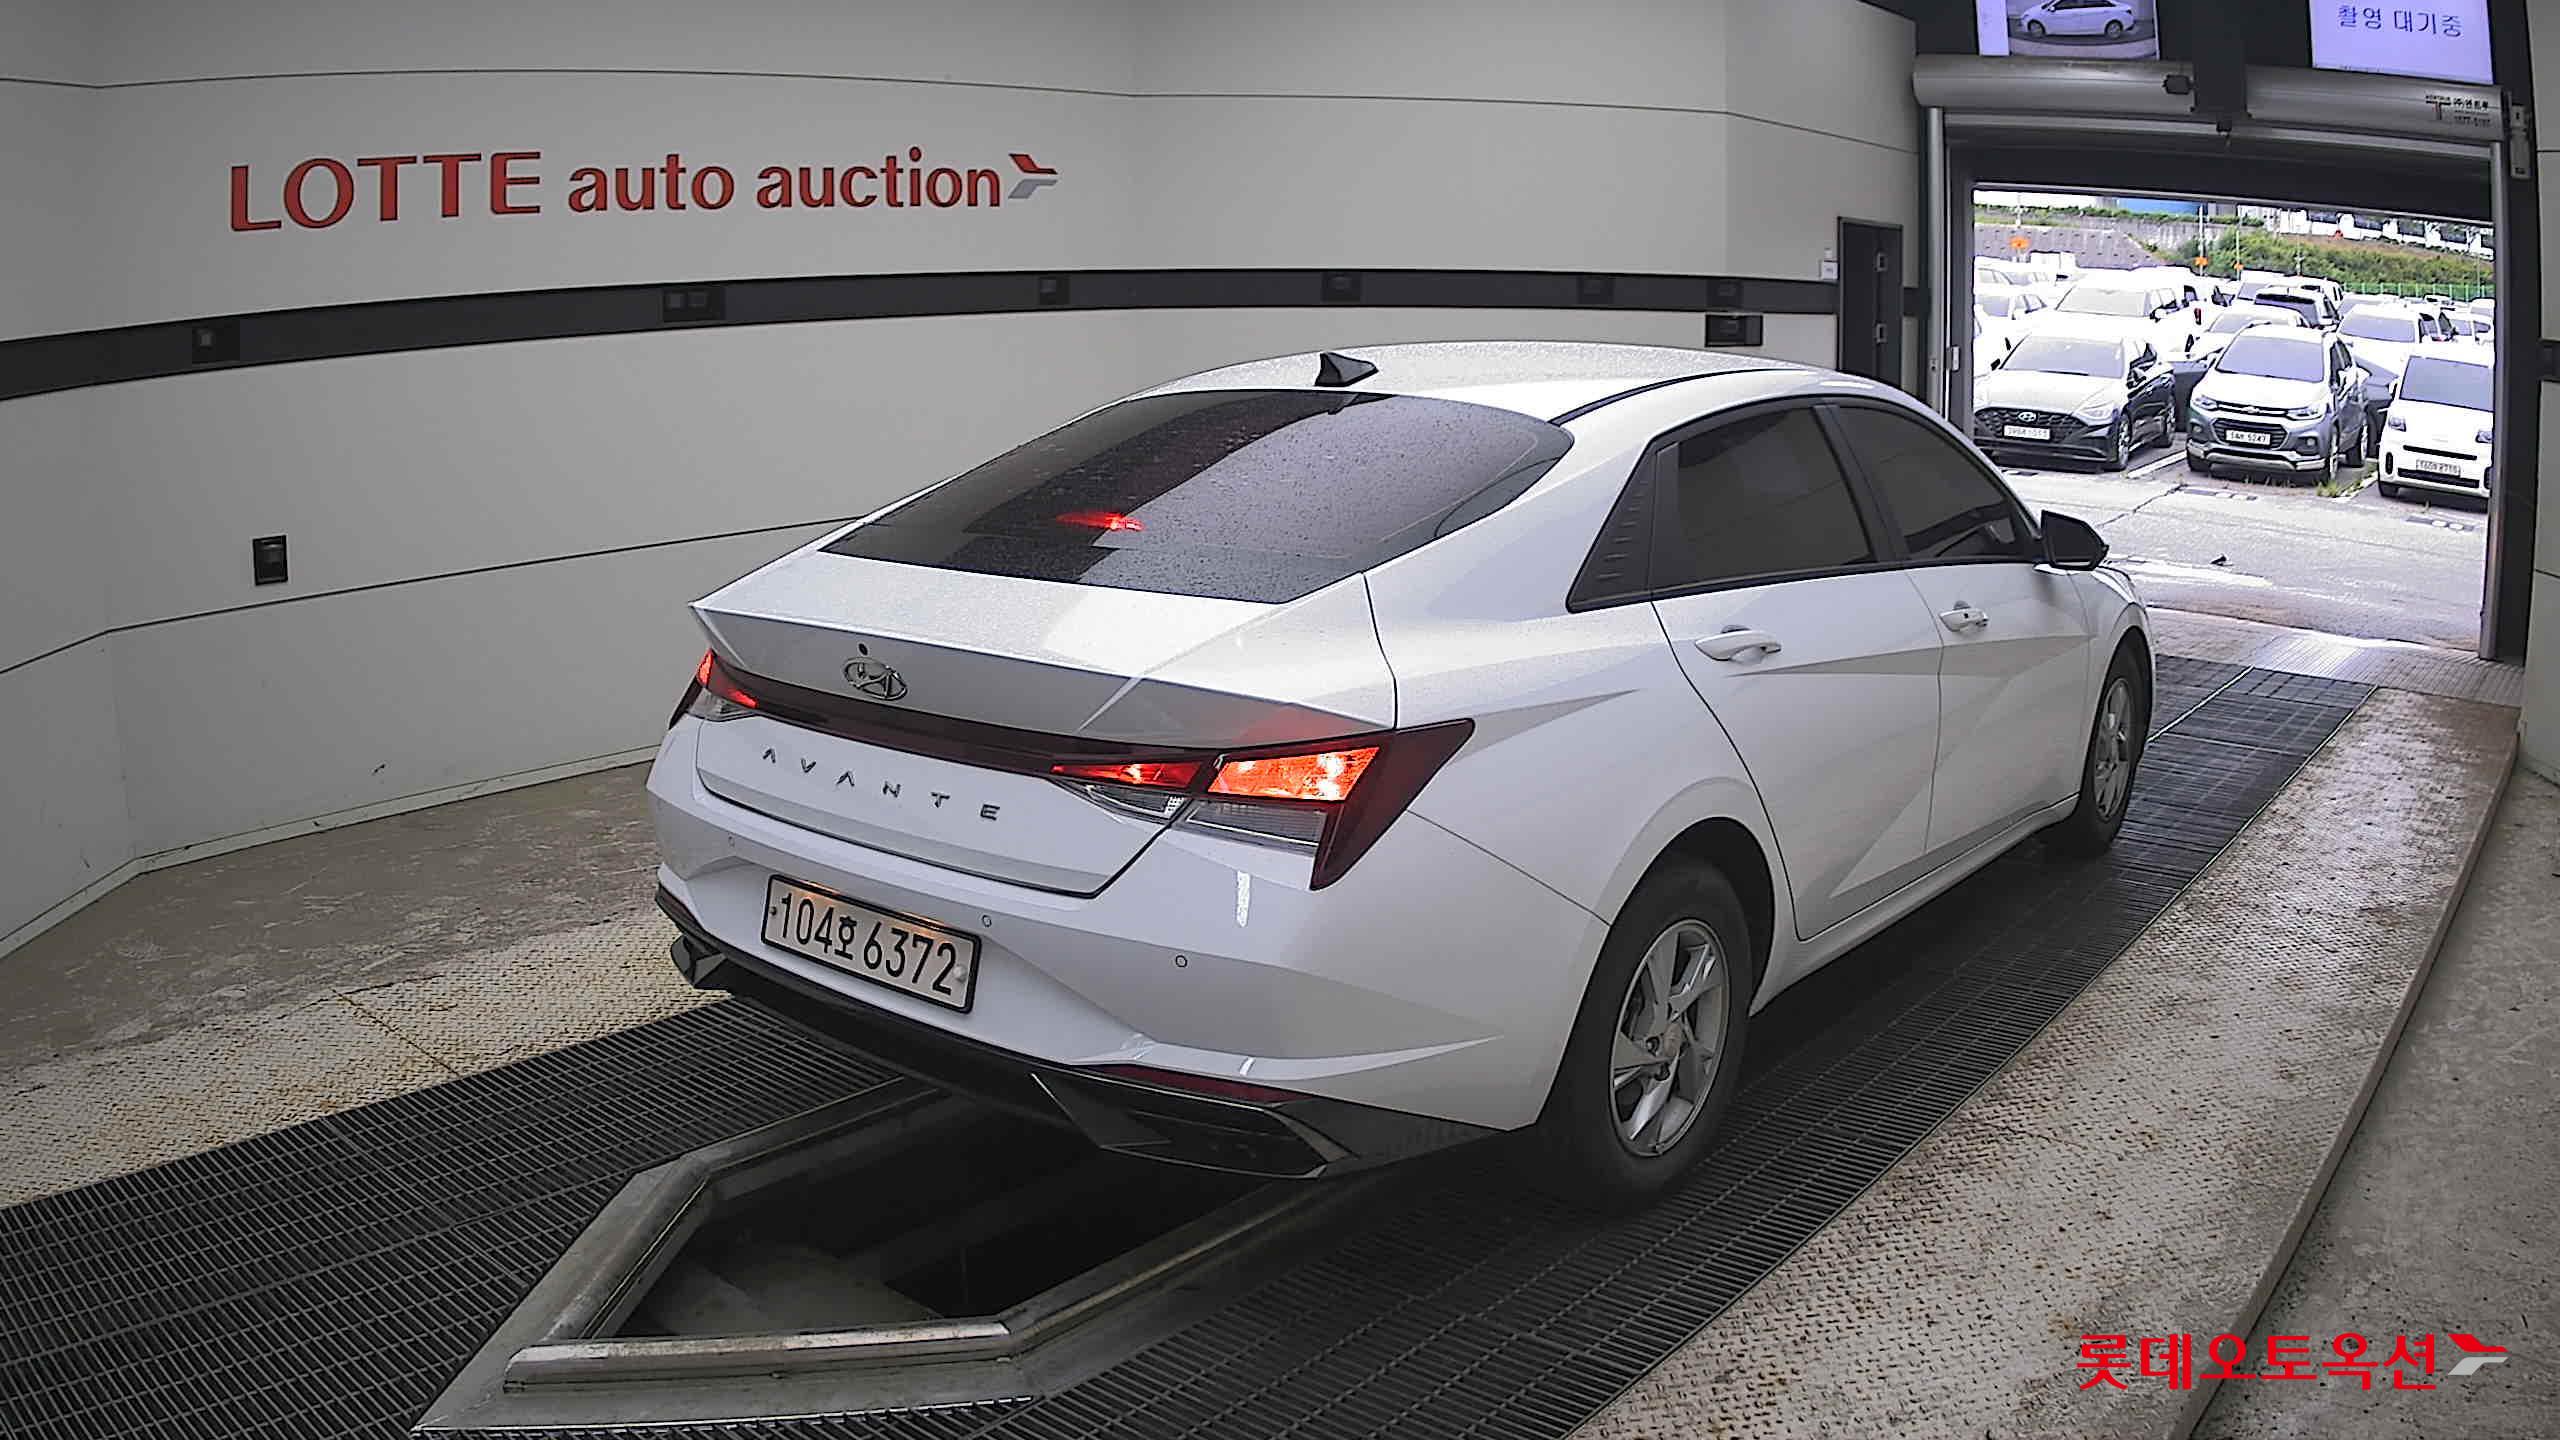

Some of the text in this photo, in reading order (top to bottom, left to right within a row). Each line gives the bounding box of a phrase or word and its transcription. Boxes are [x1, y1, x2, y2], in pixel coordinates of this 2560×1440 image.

[2338, 5, 2463, 38] 촬영 대기중
[231, 146, 1001, 232] LOTTE auto auction
[762, 748, 1001, 821] AVANTE
